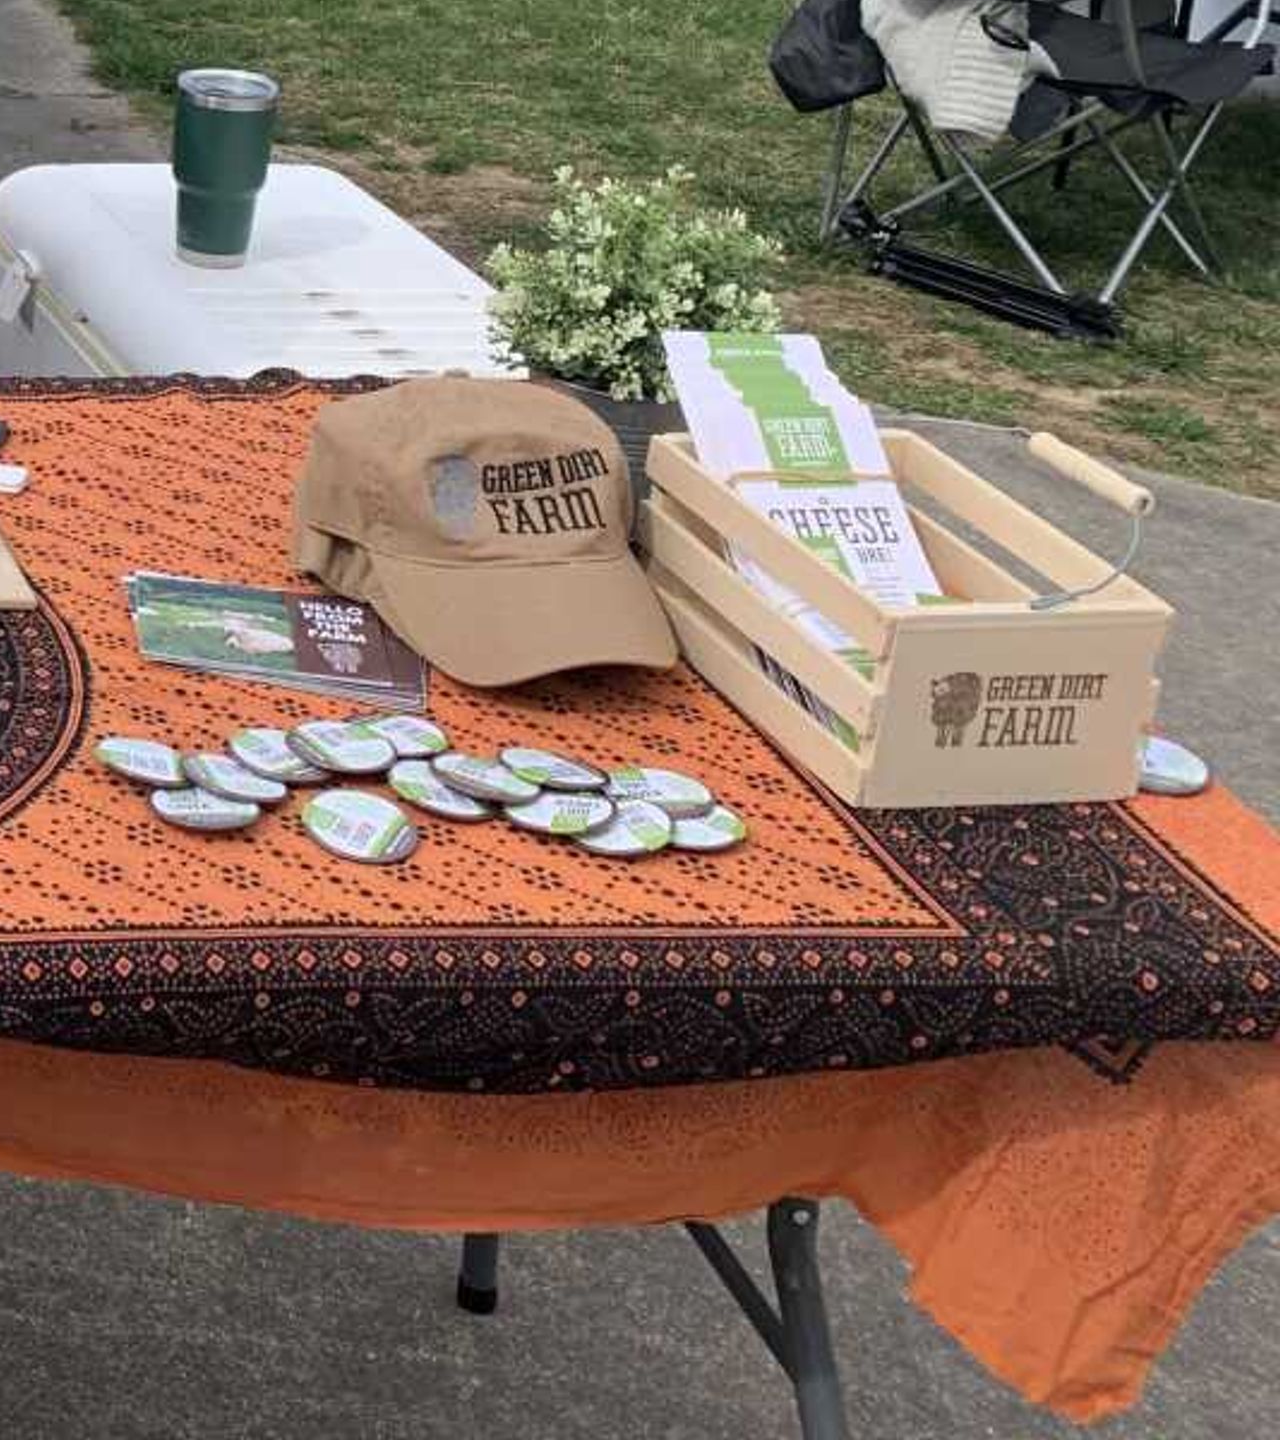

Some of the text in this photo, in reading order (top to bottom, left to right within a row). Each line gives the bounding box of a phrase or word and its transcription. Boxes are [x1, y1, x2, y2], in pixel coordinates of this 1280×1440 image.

[482, 447, 610, 494] GREEN DIRT
[486, 486, 608, 534] FARM
[299, 600, 363, 616] HELLO
[307, 628, 367, 645] FARM
[988, 674, 1107, 700] GREEN DIRT
[977, 706, 1080, 747] FARM
